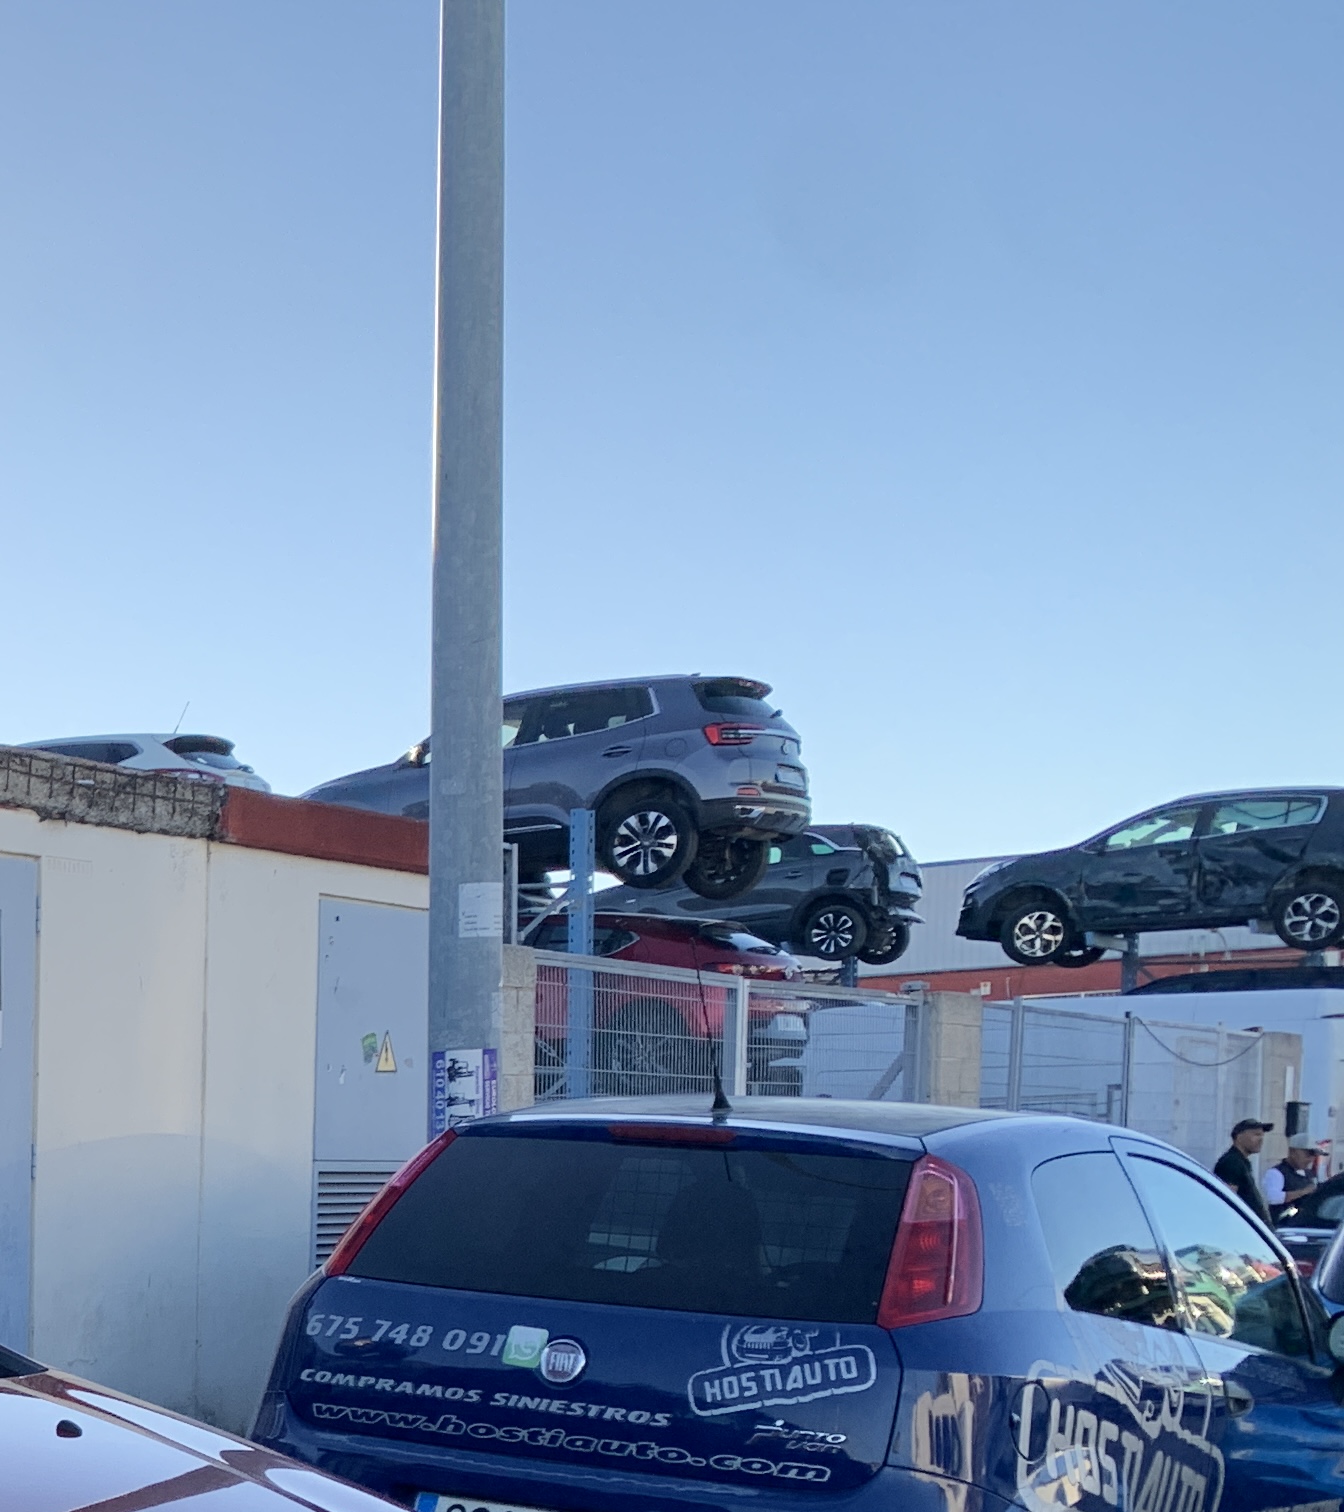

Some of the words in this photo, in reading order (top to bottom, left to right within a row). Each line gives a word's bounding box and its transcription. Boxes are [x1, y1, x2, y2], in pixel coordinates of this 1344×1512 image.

[306, 1314, 363, 1340] 675
[371, 1319, 434, 1347] 748
[442, 1329, 506, 1356] 091
[549, 1352, 577, 1371] FIAT
[704, 1356, 858, 1403] HOSTIAUTO
[300, 1368, 484, 1402] COMPRAMOS
[490, 1392, 674, 1427] SINIESTROS
[312, 1403, 831, 1482] www.hostiauto.com
